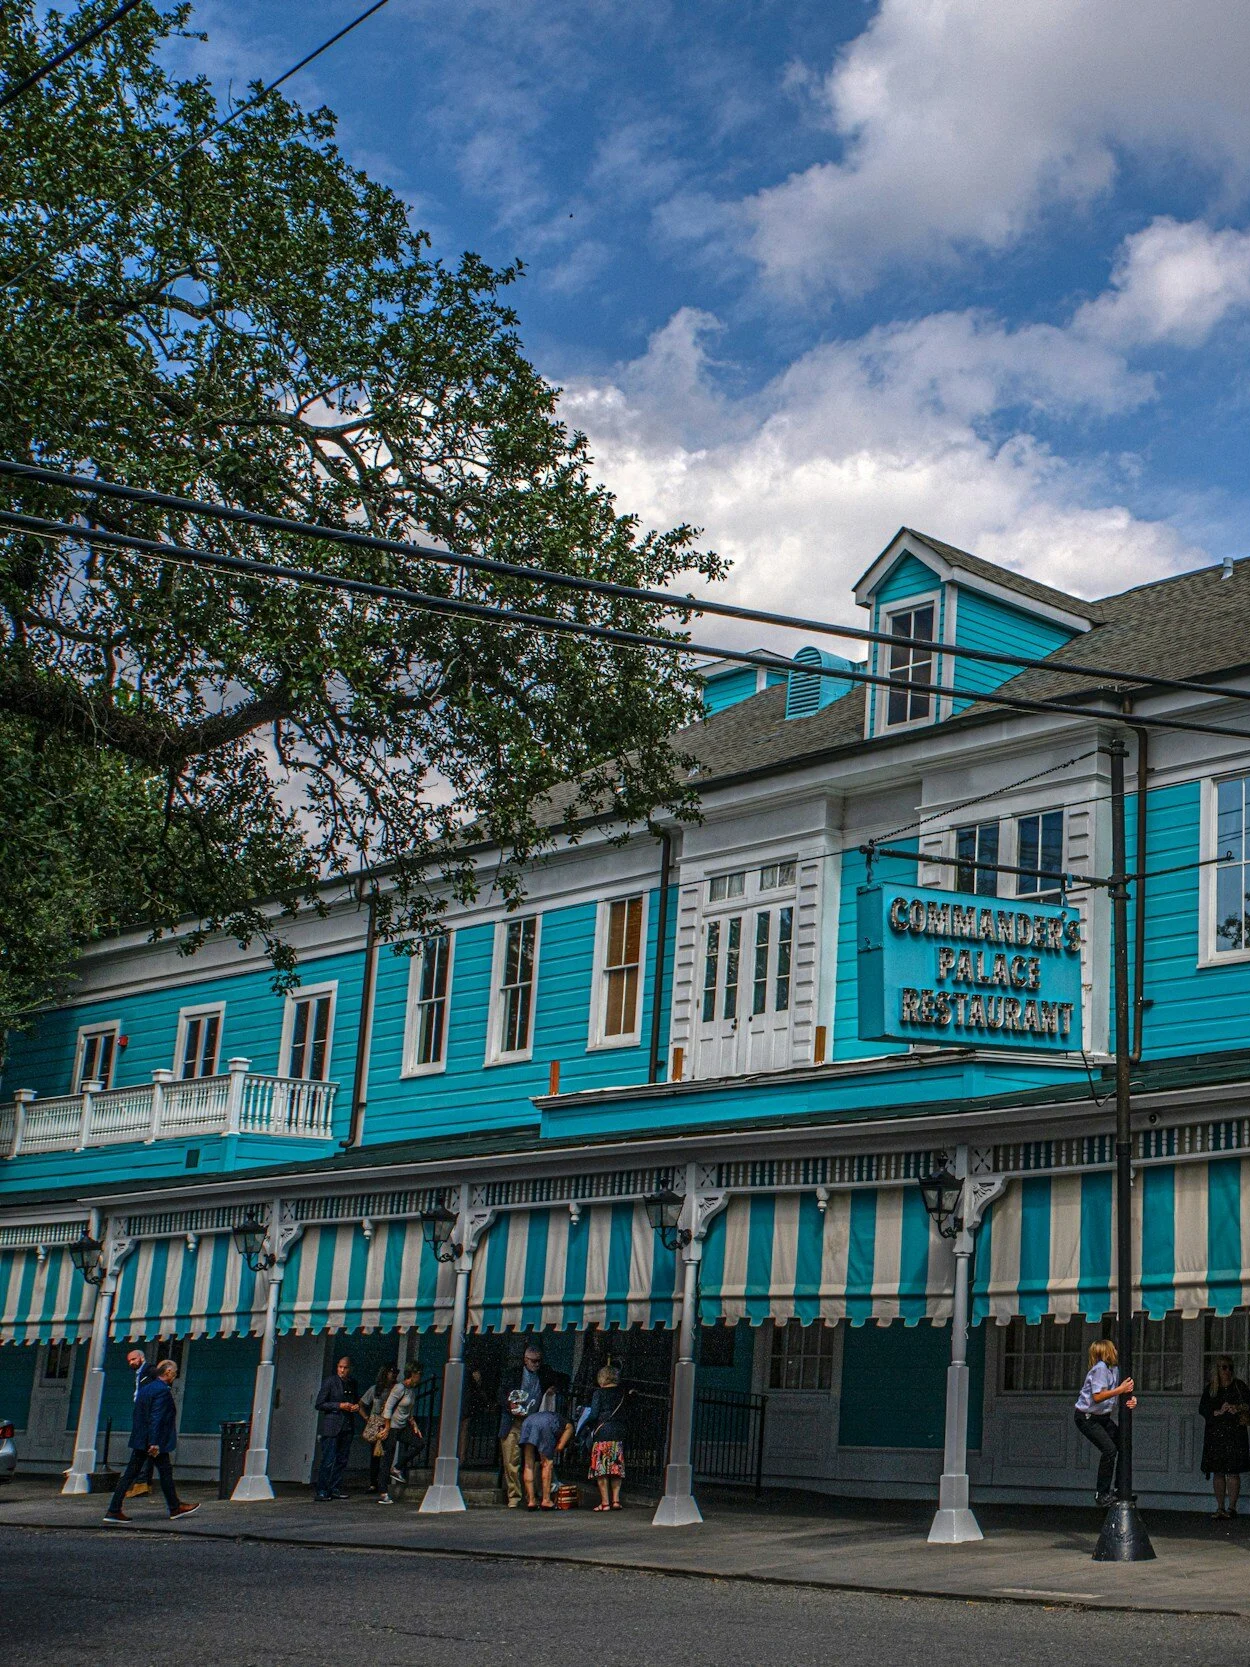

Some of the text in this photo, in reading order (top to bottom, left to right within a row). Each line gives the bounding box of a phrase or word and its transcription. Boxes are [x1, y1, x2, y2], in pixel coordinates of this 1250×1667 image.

[890, 897, 1081, 951] COMMANDER'S
[938, 947, 1041, 988] PALACE
[901, 987, 1074, 1034] RESTAURANT
